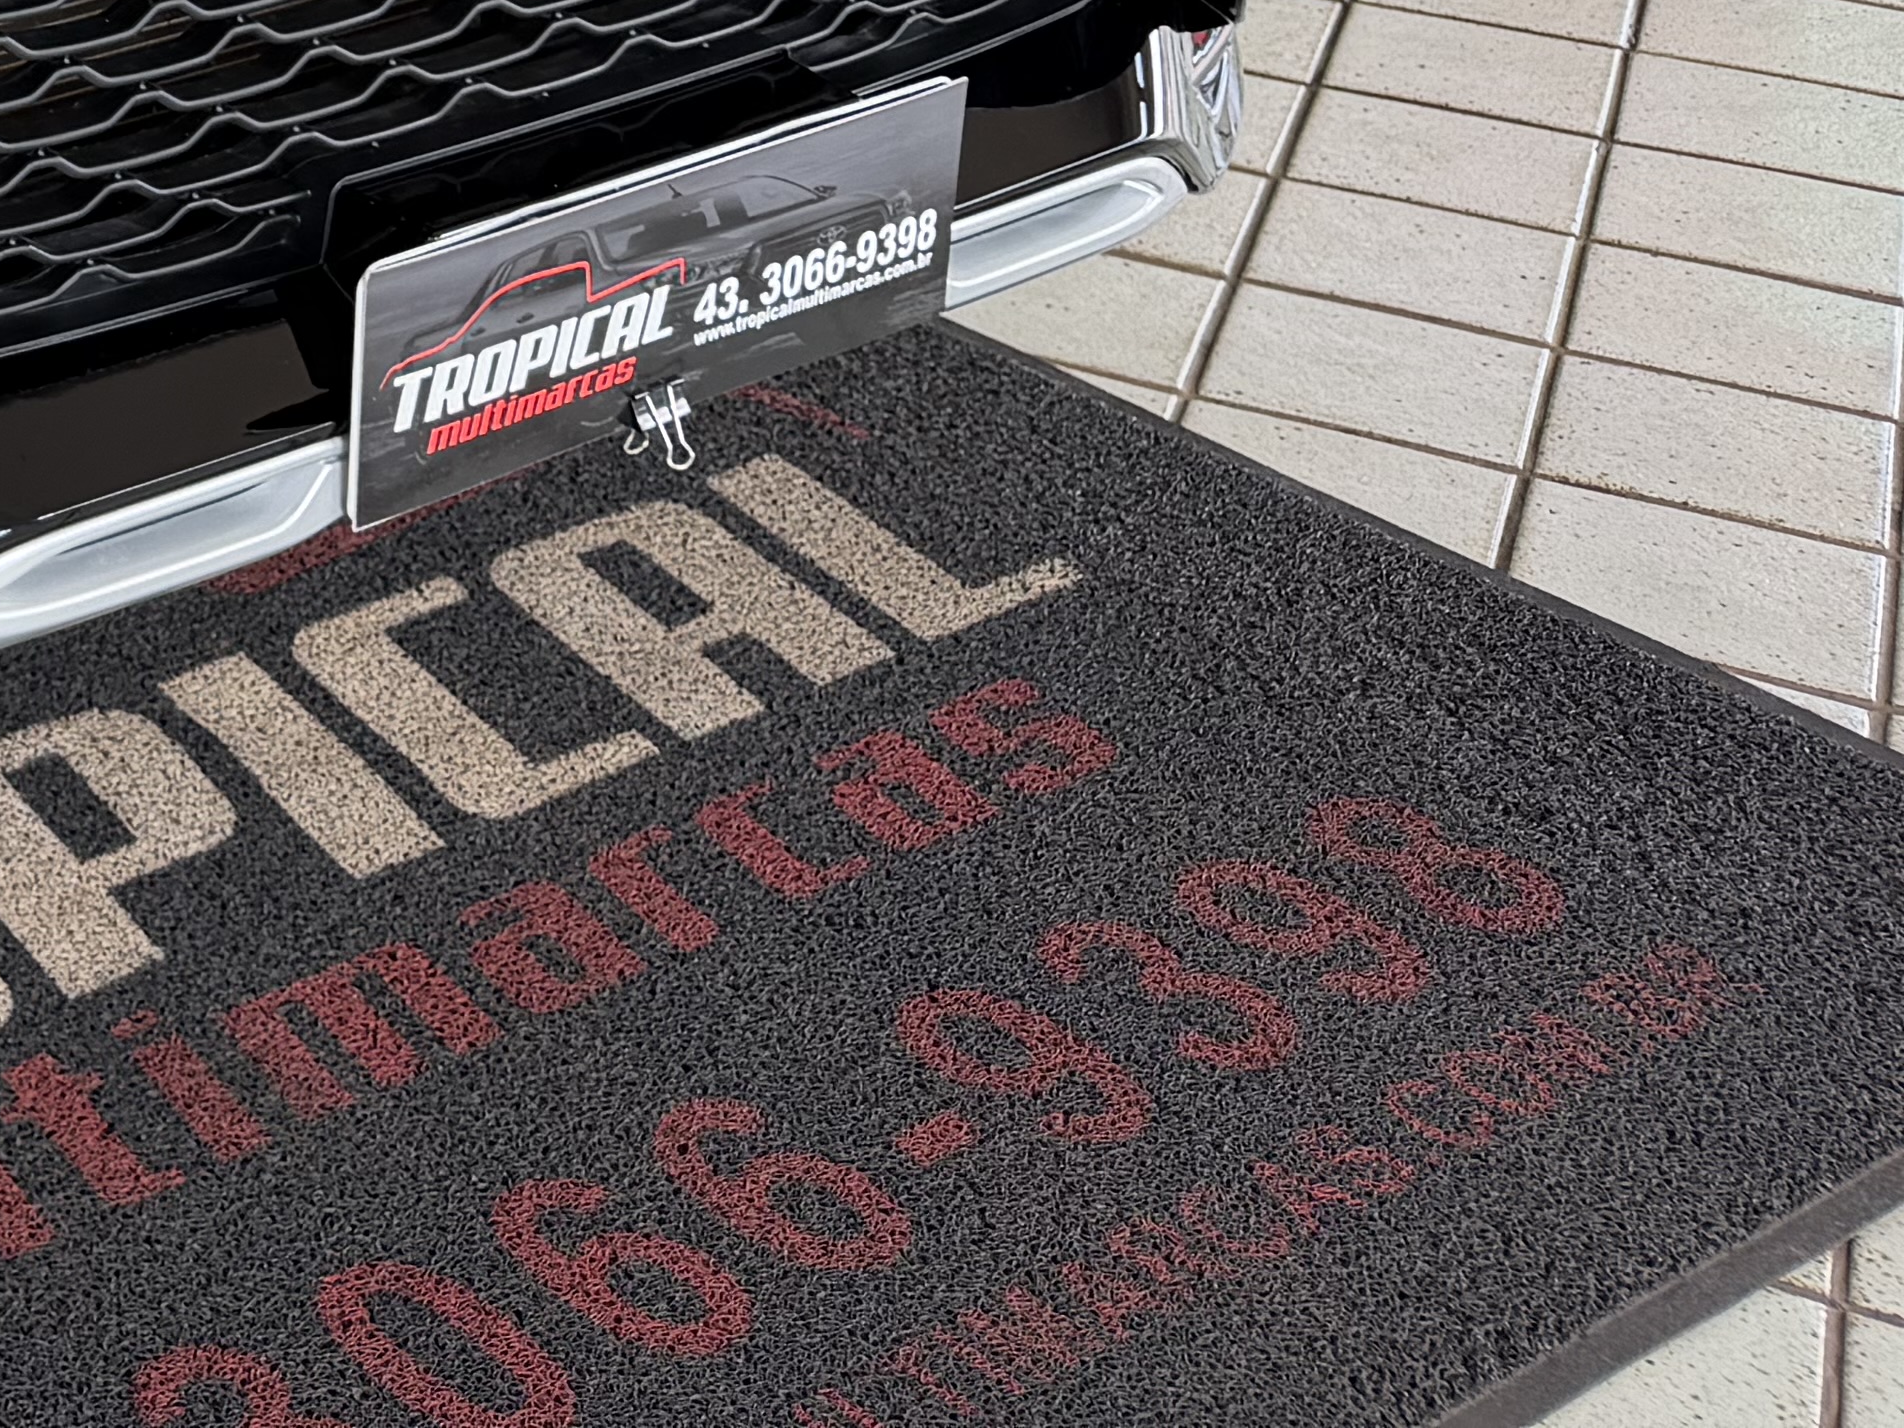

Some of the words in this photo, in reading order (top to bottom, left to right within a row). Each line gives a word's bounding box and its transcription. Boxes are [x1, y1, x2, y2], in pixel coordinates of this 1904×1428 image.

[693, 276, 749, 326] 43.
[759, 207, 938, 306] 3066-9398
[693, 251, 934, 347] www.tropicalmultimarcas.com.br
[393, 284, 674, 434] TROPICAL
[426, 355, 638, 456] multimarcas
